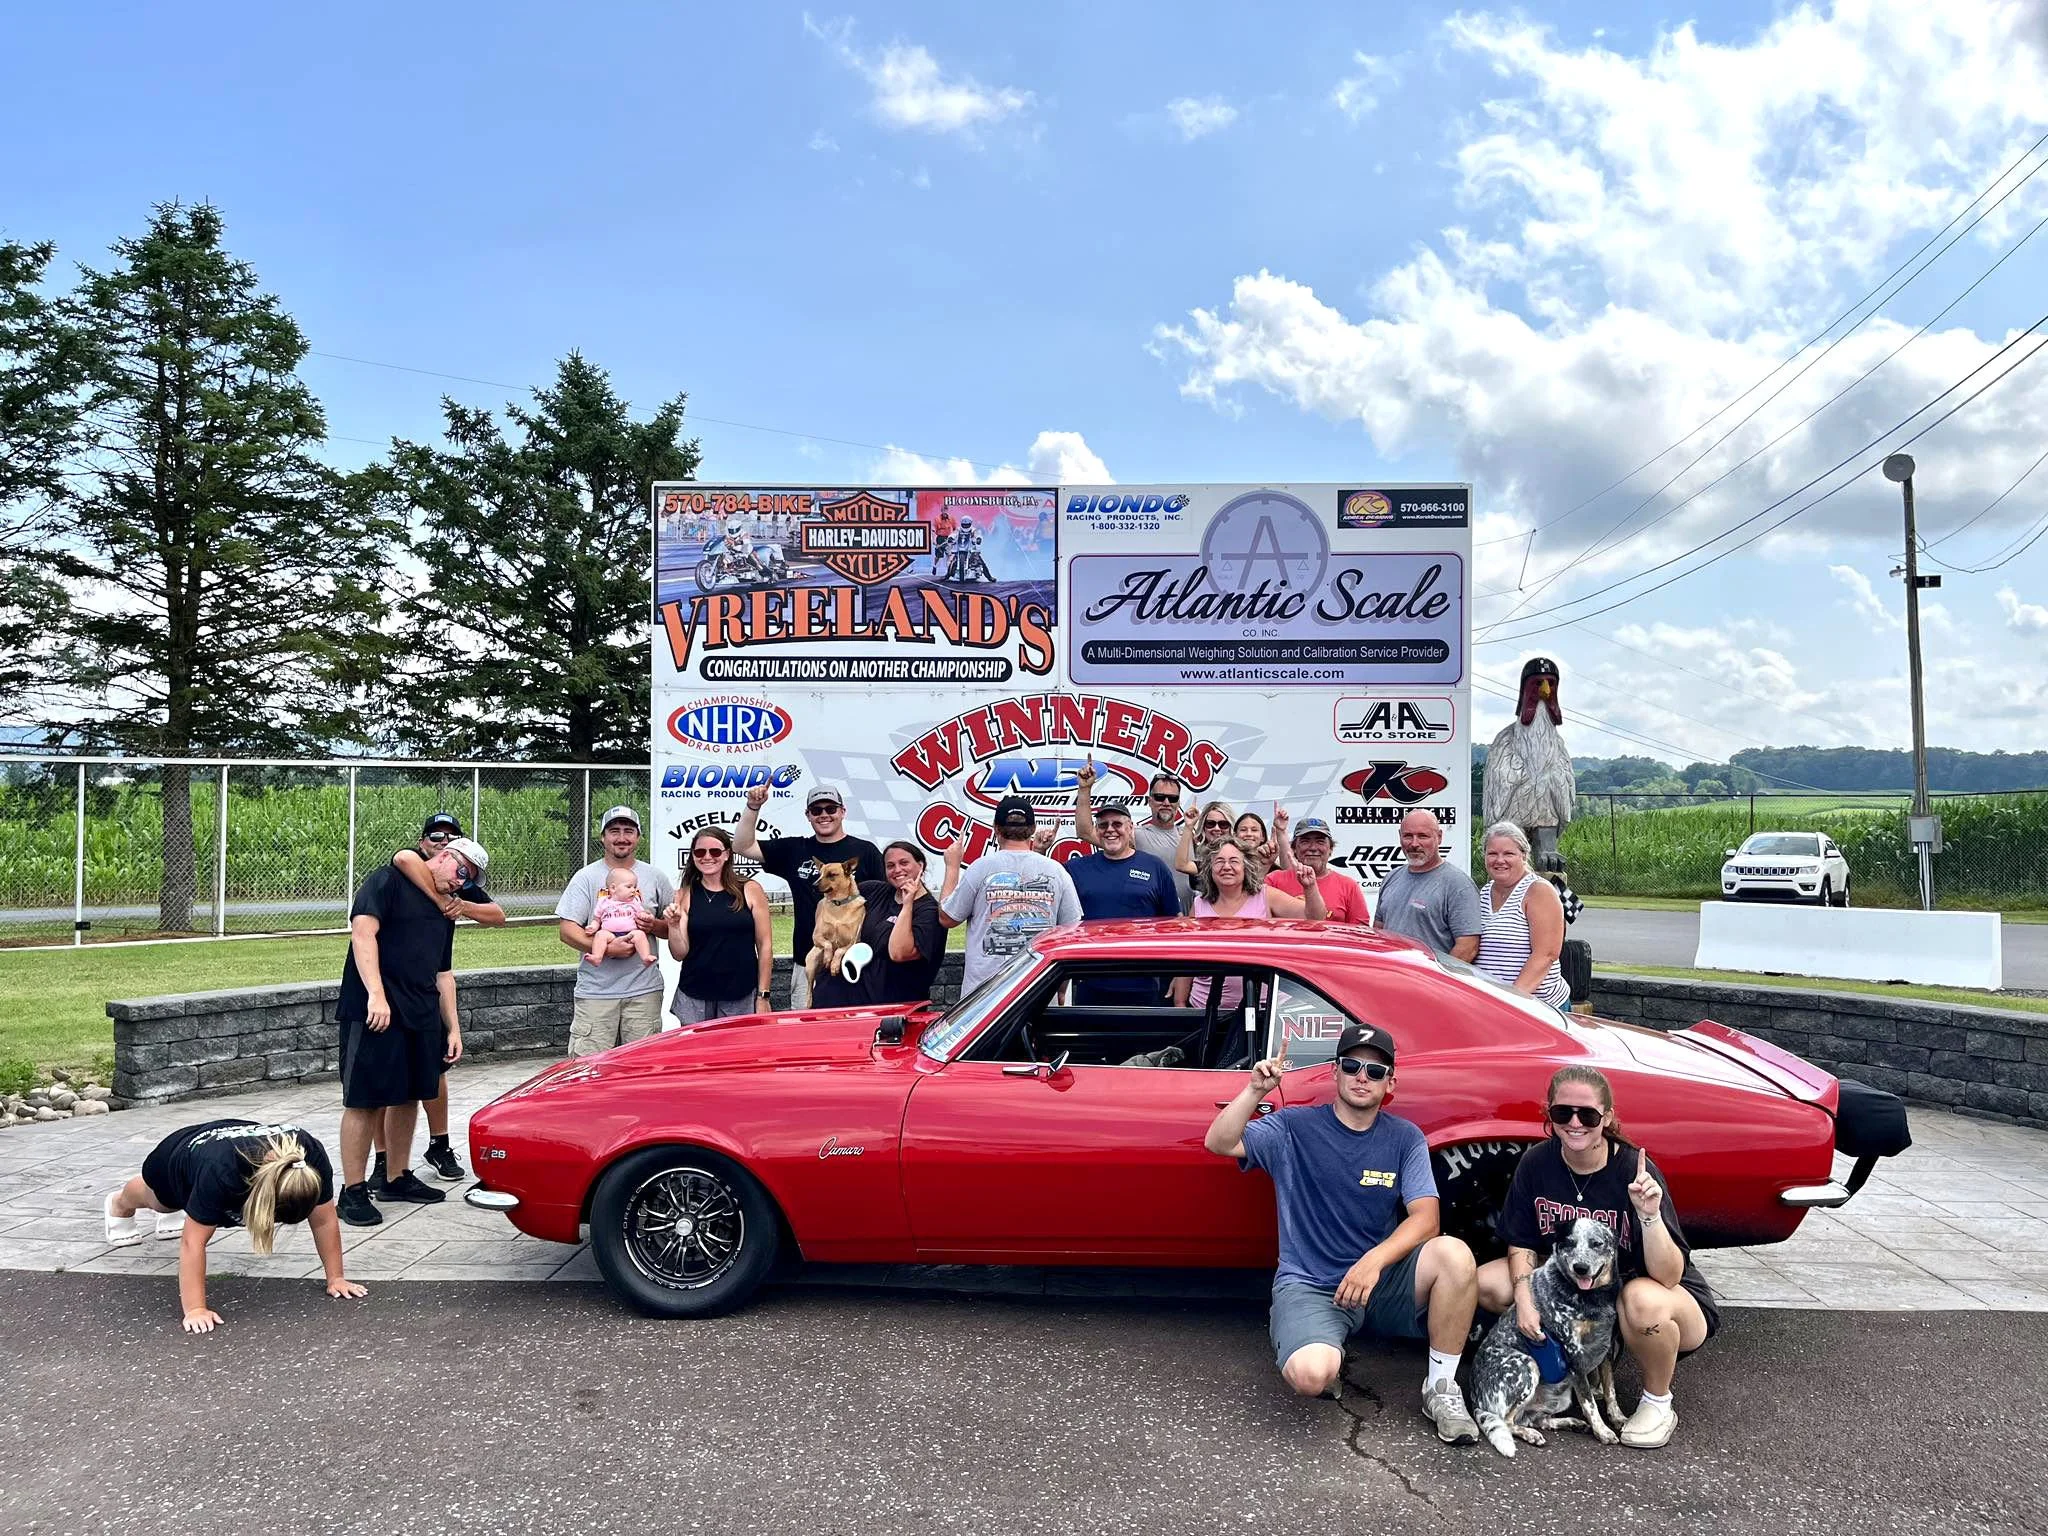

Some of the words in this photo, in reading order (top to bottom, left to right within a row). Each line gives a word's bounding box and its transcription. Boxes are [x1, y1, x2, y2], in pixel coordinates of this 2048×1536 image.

[664, 494, 812, 514] 570-784-BIKE
[834, 499, 896, 521] MOTOR
[1066, 495, 1187, 513] BIONDO
[1400, 503, 1465, 512] 570-966-3100
[808, 528, 924, 547] HARLEY-DAVIDSON
[836, 554, 899, 579] CYCLES
[1083, 566, 1305, 623] Atlantic
[1315, 564, 1450, 623] Scale
[659, 585, 1055, 675] VREELAND'S
[1087, 648, 1095, 658] A
[1098, 647, 1186, 658] Multi-Dimensional
[1188, 647, 1235, 661] Weighing
[1238, 647, 1279, 658] Solution
[1281, 647, 1300, 658] and
[1303, 646, 1357, 658] Calibration
[1360, 646, 1398, 658] Service
[1401, 646, 1444, 658] Provider
[706, 659, 827, 678] CONGRATULATIONS
[829, 660, 847, 678] ON
[850, 660, 908, 678] ANOTHER
[911, 660, 1007, 679] CHAMPIONSHIP
[1180, 668, 1345, 679] www.atlanticscale.com
[687, 695, 774, 711] CHAMPIONSHIP
[688, 706, 775, 743] NHRA
[688, 740, 720, 753] DRAG
[726, 739, 773, 754] RACING
[891, 693, 1229, 792] WINNERS
[661, 765, 797, 788] BIONDO
[1336, 808, 1383, 818] KOREK
[668, 811, 782, 840] VREELAD'S
[1358, 1029, 1375, 1041] 7
[819, 1136, 864, 1160] Camaro
